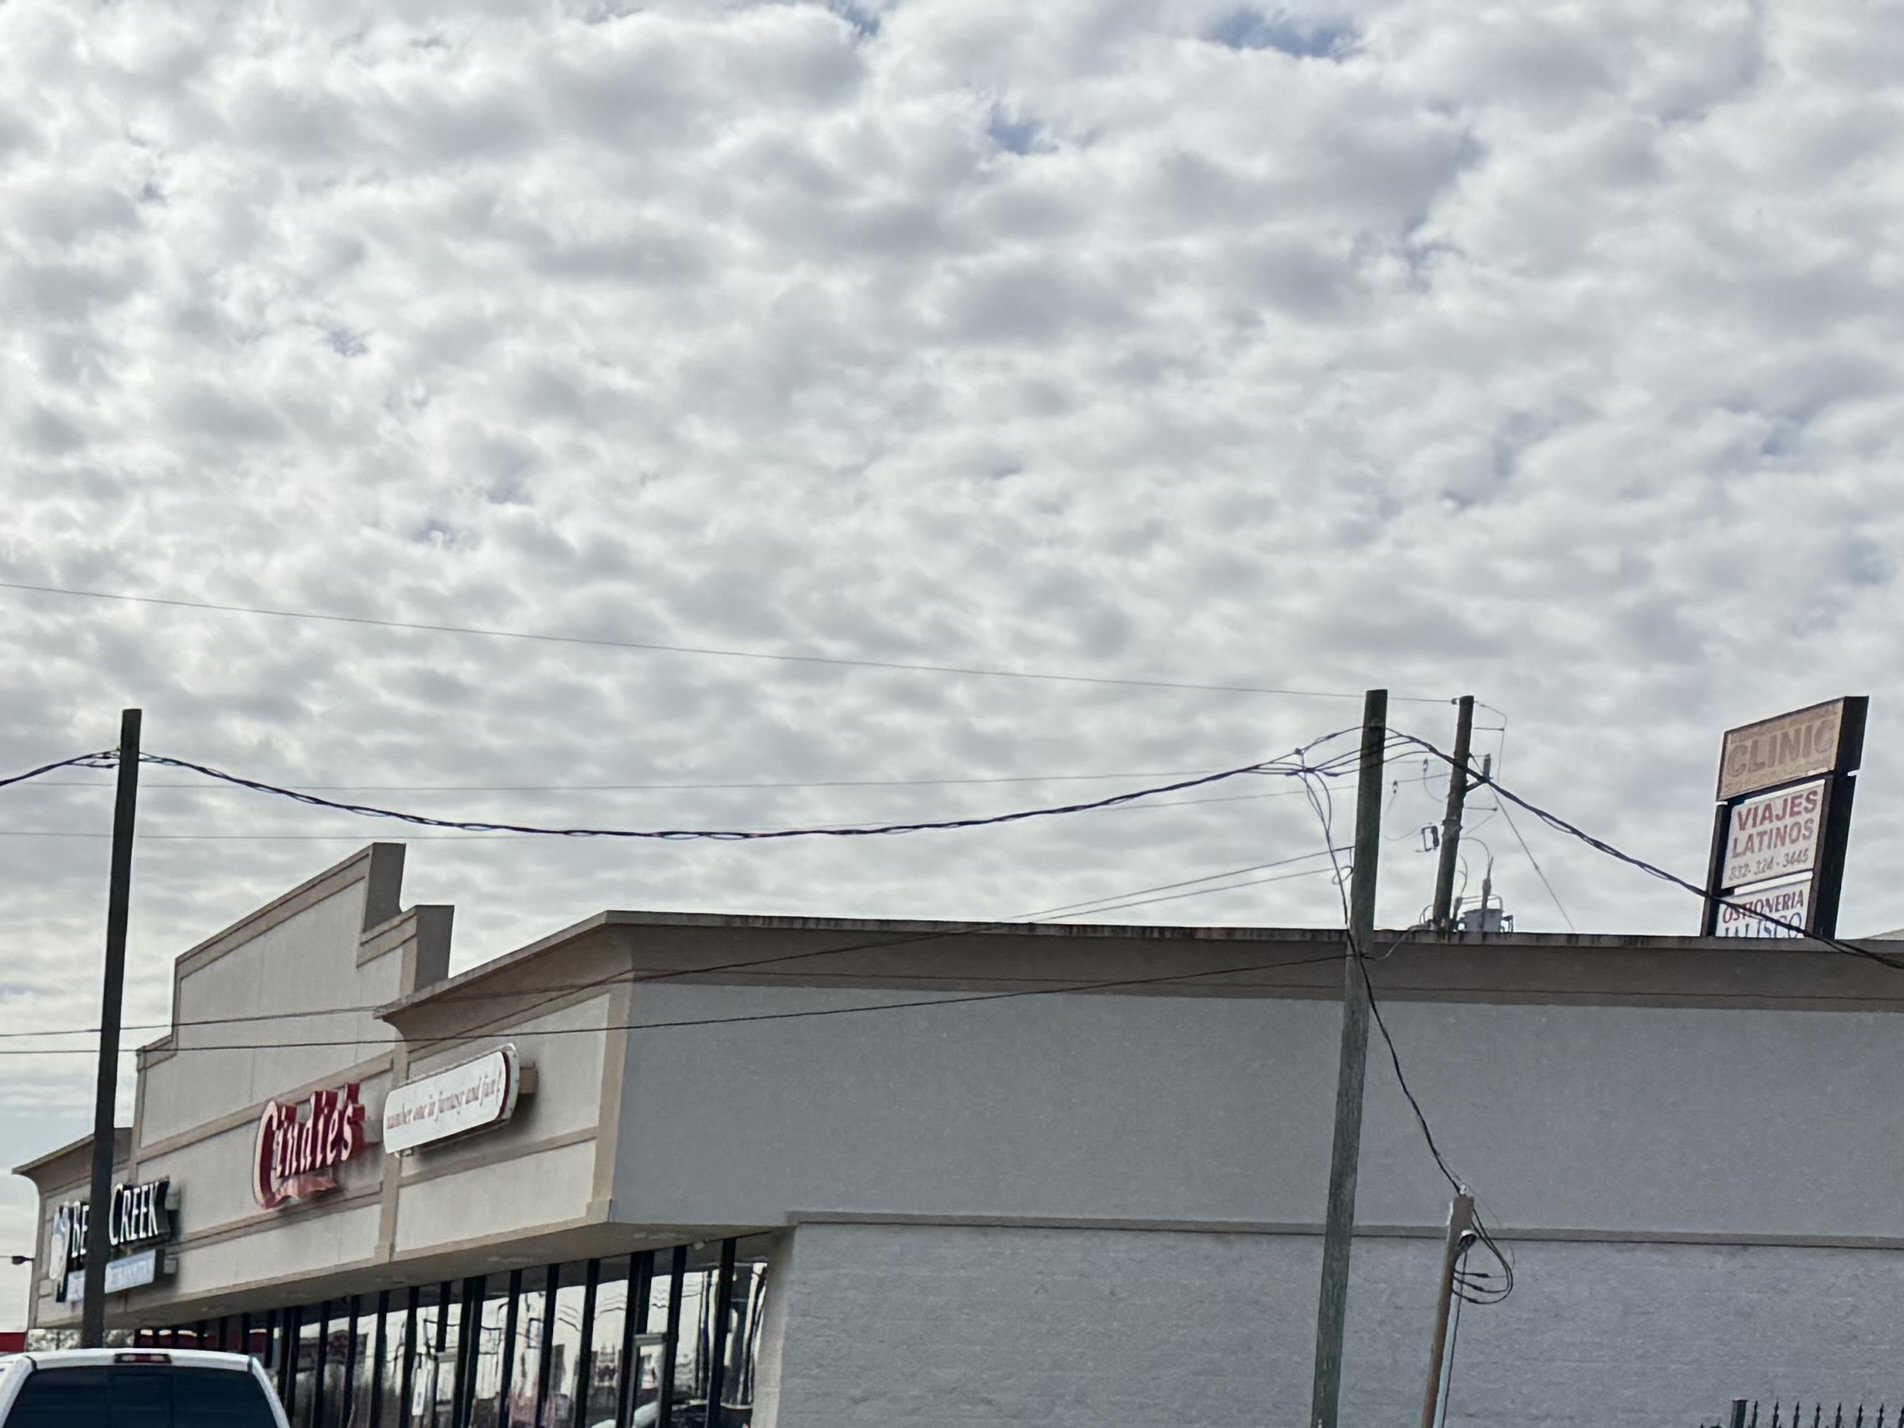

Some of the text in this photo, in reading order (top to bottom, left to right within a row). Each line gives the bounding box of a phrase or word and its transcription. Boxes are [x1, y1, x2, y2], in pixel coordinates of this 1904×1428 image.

[1727, 719, 1836, 777] CLINIC
[1732, 818, 1814, 859] LATINOS
[1737, 790, 1818, 831] VIAJES
[253, 1083, 365, 1209] Cindie's
[109, 1182, 160, 1246] CREEK
